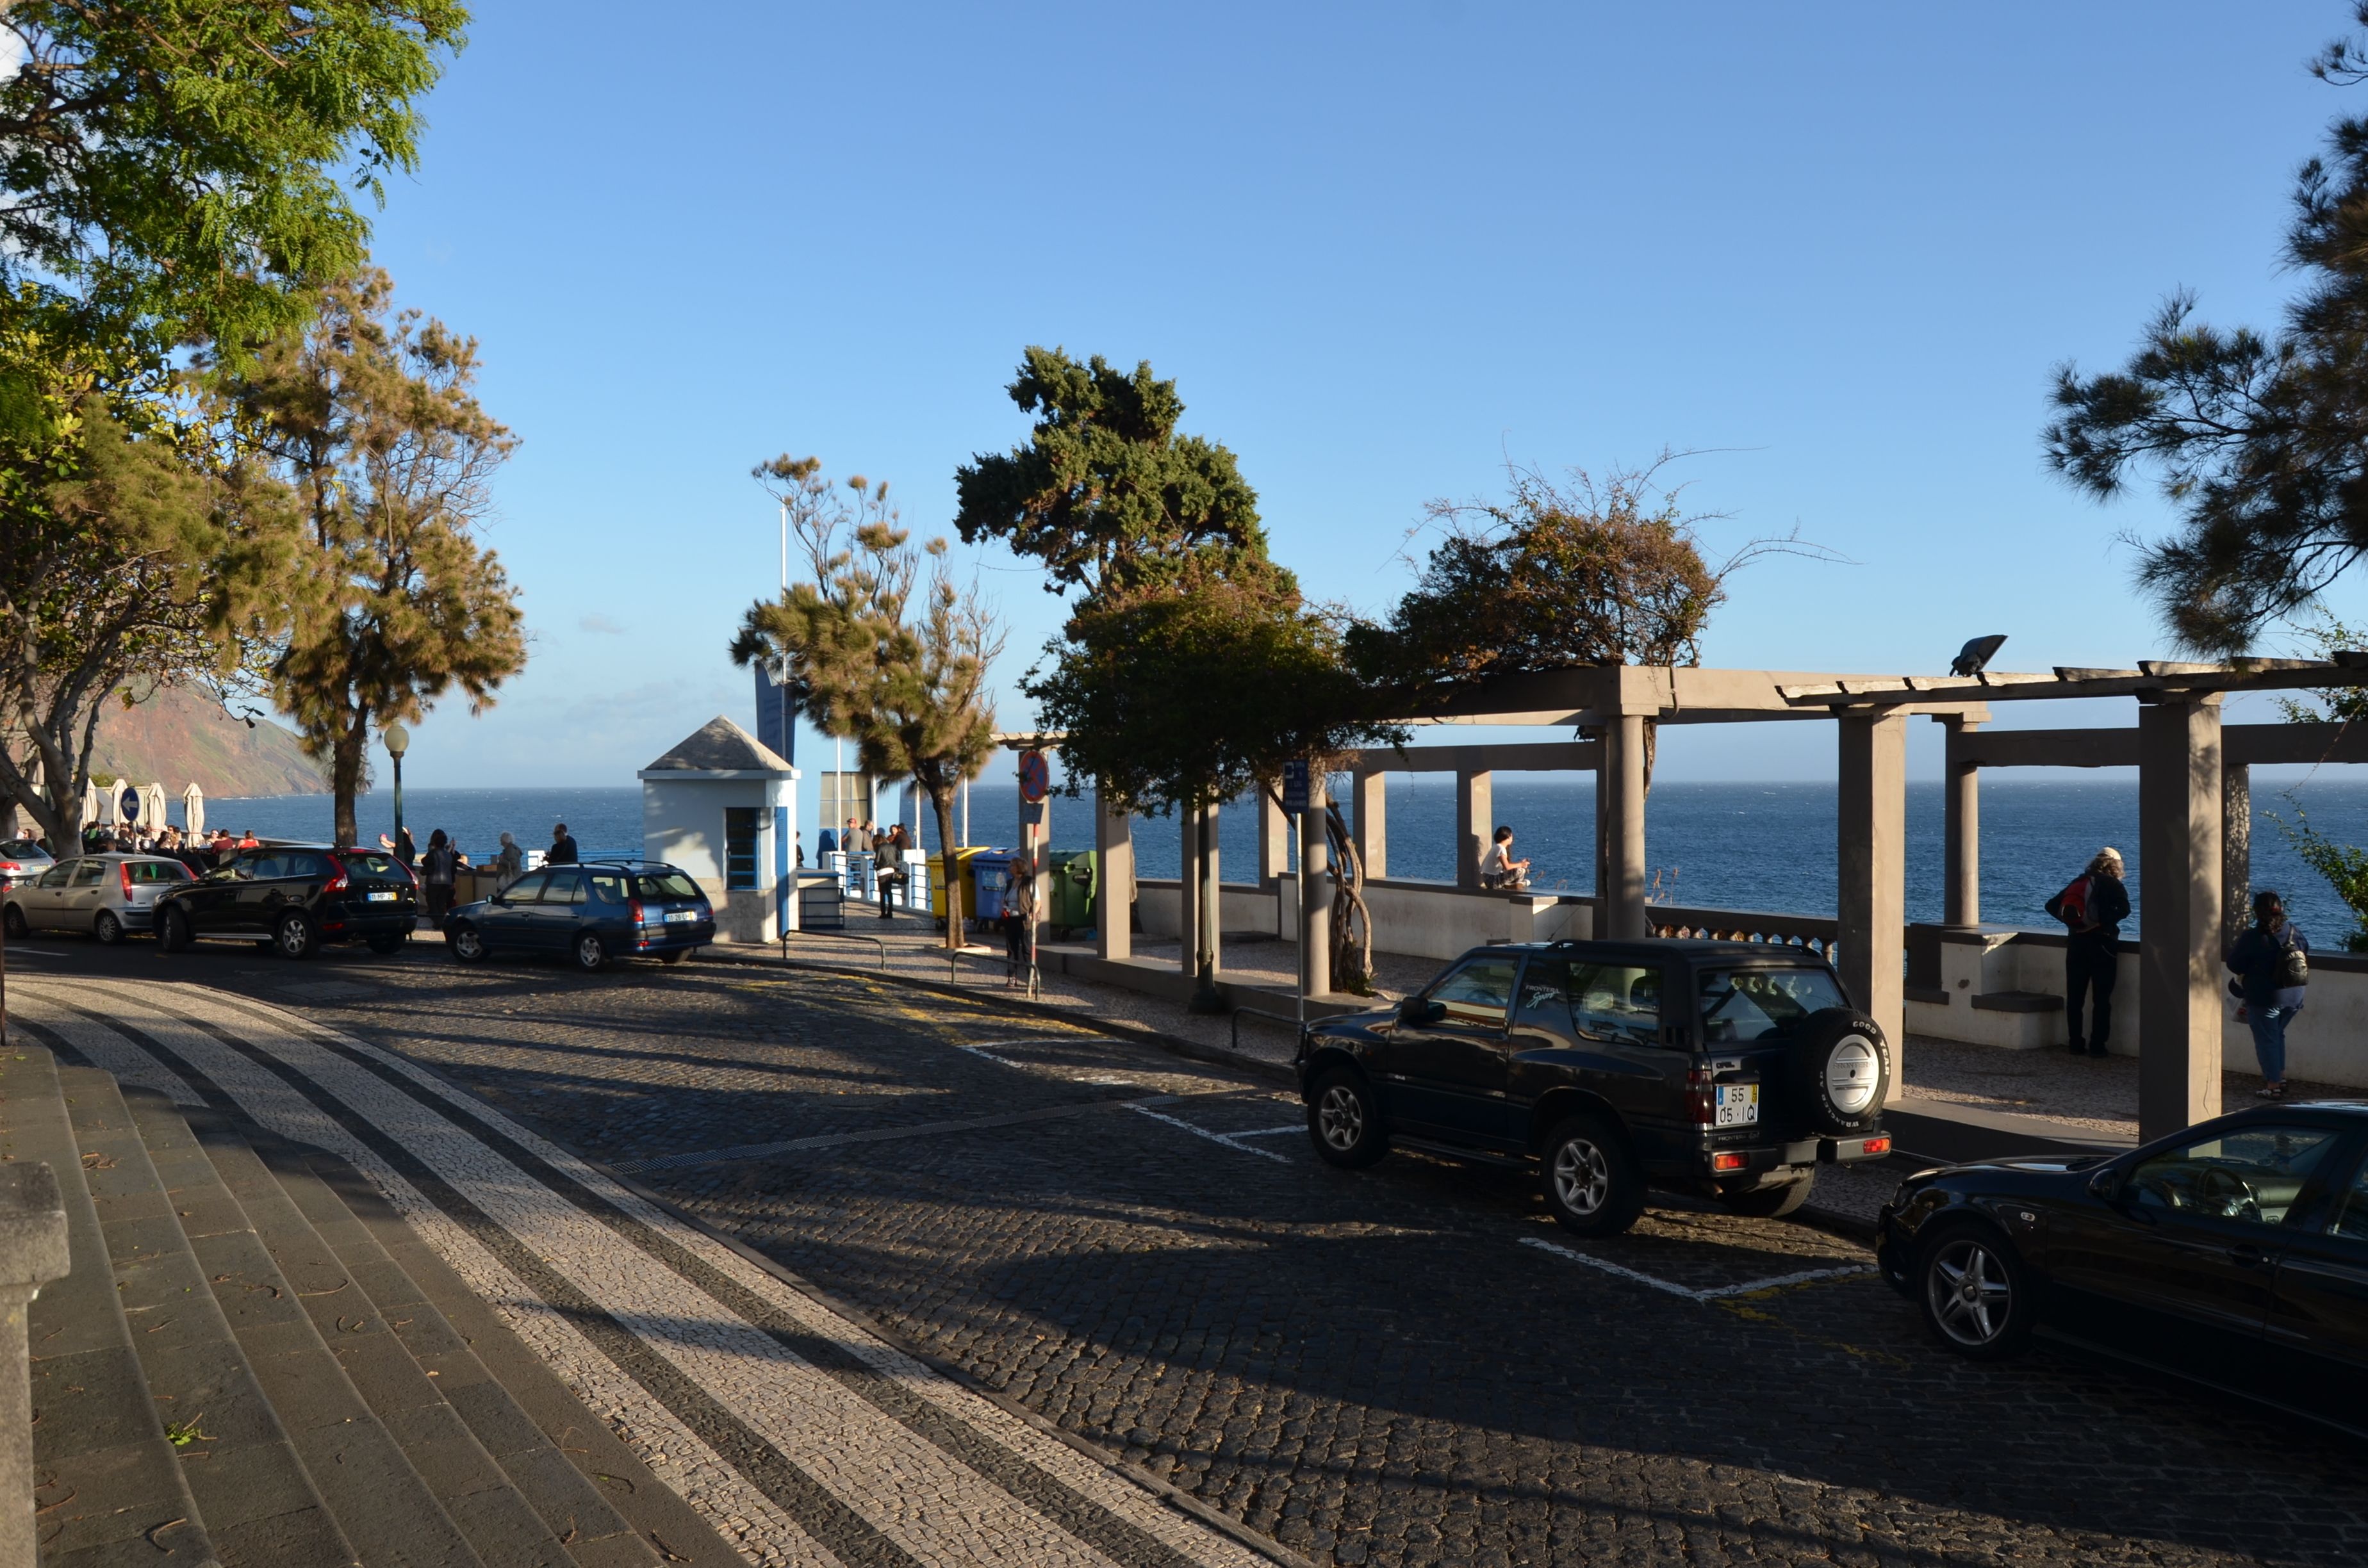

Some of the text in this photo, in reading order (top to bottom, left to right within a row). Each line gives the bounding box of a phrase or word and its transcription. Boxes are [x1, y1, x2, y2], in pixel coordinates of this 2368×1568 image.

[1525, 984, 1559, 993] FRONTERA
[1852, 1021, 1891, 1076] GOOD YEAR
[1832, 1061, 1875, 1070] FRONTERA
[1731, 1088, 1745, 1103] 55
[1821, 1094, 1860, 1128] WRANGLER
